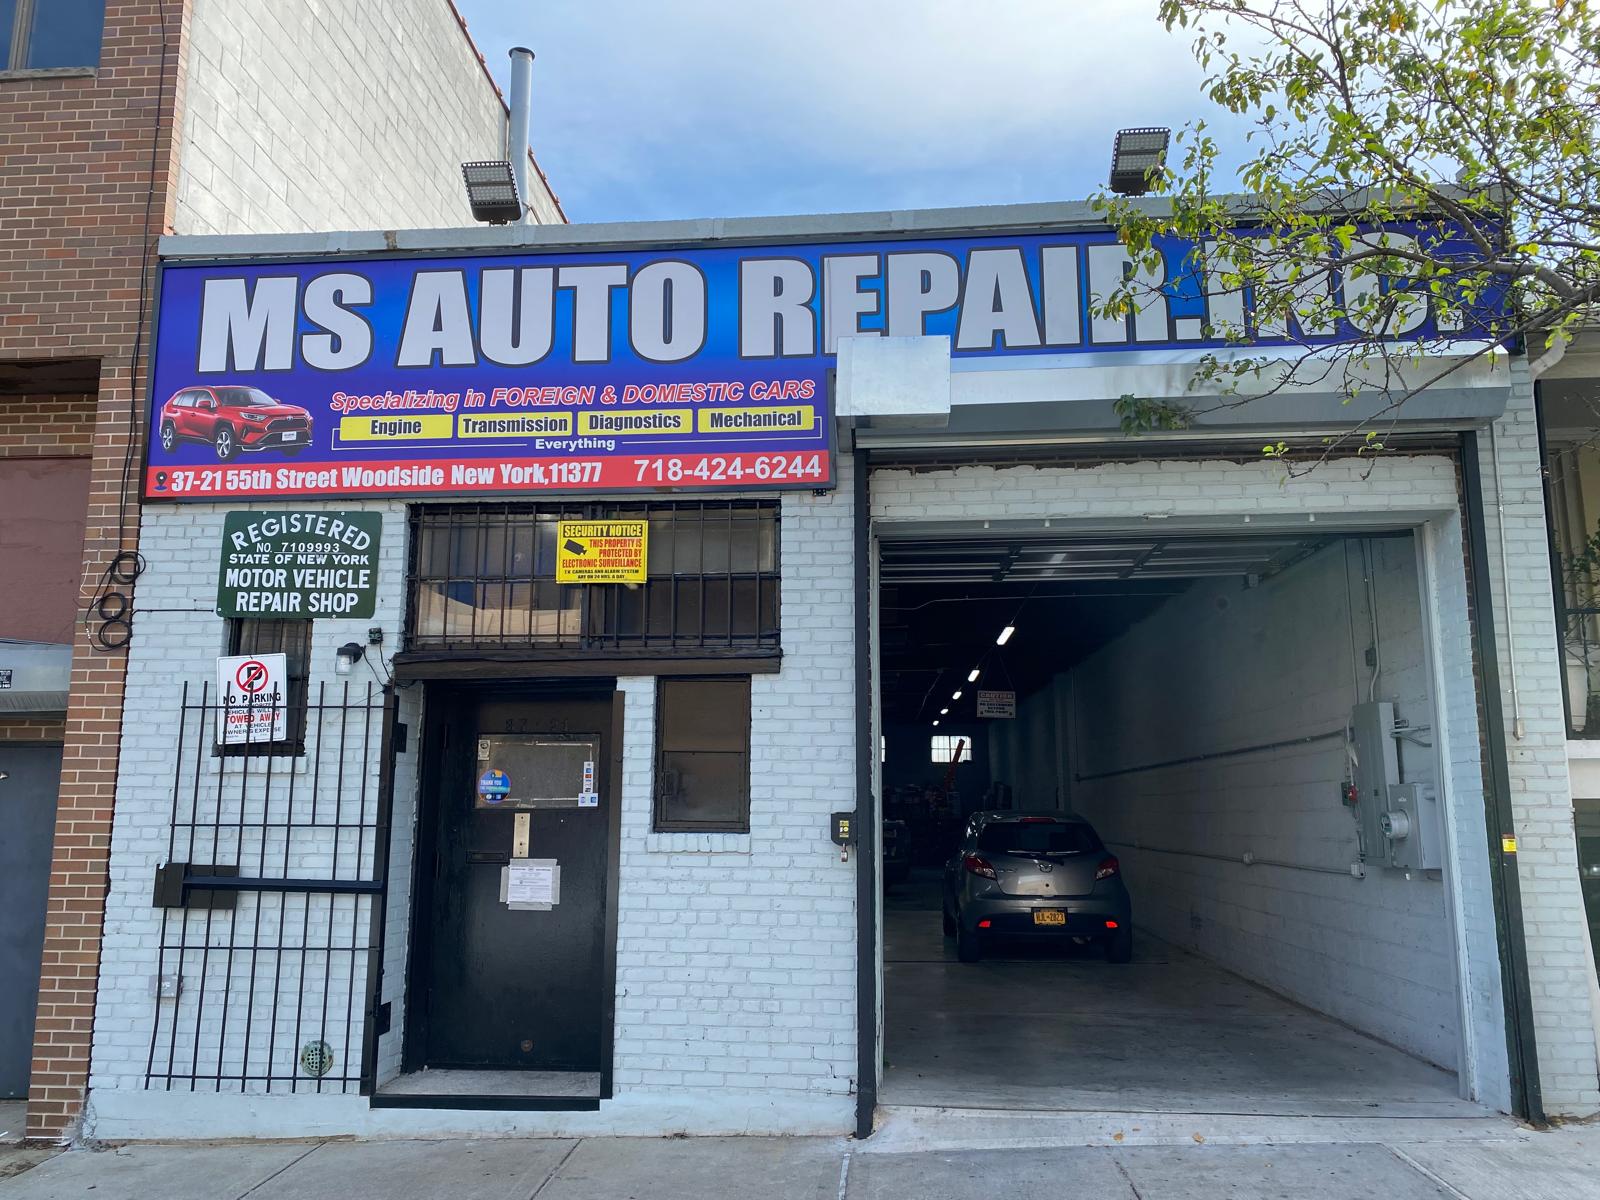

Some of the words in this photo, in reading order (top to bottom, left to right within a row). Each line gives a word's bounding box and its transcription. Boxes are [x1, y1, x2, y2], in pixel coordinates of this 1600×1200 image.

[198, 273, 373, 372] MS
[396, 261, 706, 366] AUTO
[330, 389, 460, 414] Specializing
[464, 389, 485, 408] in
[490, 386, 595, 407] FOREIGN
[600, 385, 617, 405] &
[622, 382, 744, 404] DOMESTIC
[750, 379, 815, 400] CARS
[463, 417, 568, 433] Transmission
[589, 413, 681, 431] Diagnostics
[710, 410, 802, 428] Mechanical
[371, 419, 421, 436] Engine
[535, 438, 615, 451] Everything
[171, 470, 222, 491] 37-21
[226, 469, 272, 490] 55th
[276, 468, 338, 489] Street
[342, 465, 444, 488] Woodside
[451, 465, 495, 485] New
[633, 454, 822, 482] 718-424-6244
[230, 513, 371, 551] REGISTERED
[564, 525, 608, 537] SECURITY
[609, 525, 641, 536] NOTICE
[281, 542, 340, 553] 7109993
[589, 539, 603, 547] THIS
[604, 539, 634, 548] PROPERTY
[635, 538, 642, 547] IS
[229, 553, 270, 564] STATE
[274, 554, 293, 565] OF
[297, 554, 327, 565] NEW
[332, 555, 369, 565] YORK
[599, 549, 633, 557] PROTECTED
[634, 549, 642, 557] BY
[562, 559, 598, 568] ELECTRONIC
[599, 559, 641, 567] SURVEILLANCE
[225, 568, 287, 588] MOTOR
[293, 569, 371, 588] VEHICLE
[235, 591, 301, 612] REPAIR
[308, 592, 359, 613] SHOP
[242, 693, 281, 703] PRKING
[260, 713, 280, 722] AWY
